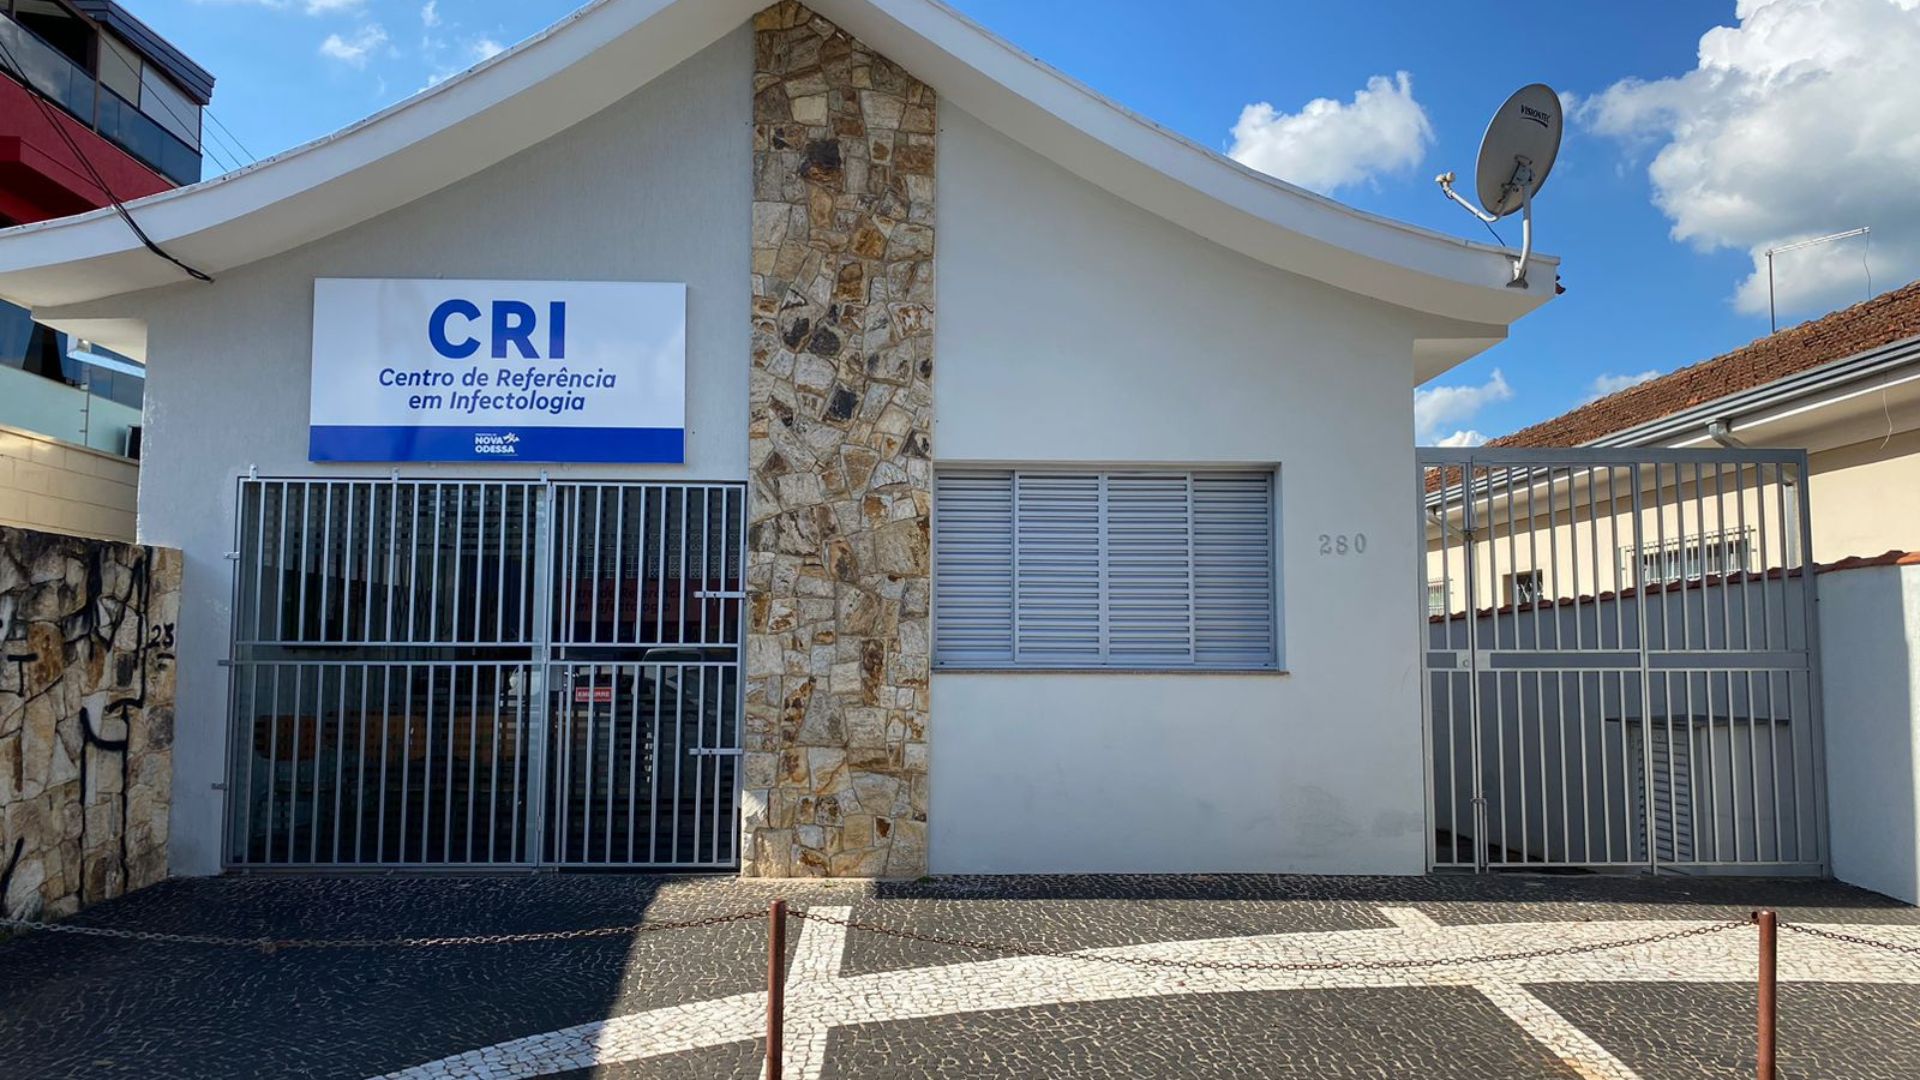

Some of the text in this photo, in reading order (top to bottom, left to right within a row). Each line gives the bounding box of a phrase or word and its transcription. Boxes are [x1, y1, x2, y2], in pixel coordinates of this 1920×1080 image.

[428, 298, 566, 359] CRI
[379, 366, 617, 391] Centro de Referência
[408, 389, 585, 414] em Infectologia
[475, 436, 503, 444] NOVA
[475, 445, 515, 453] ODESSA
[1318, 532, 1367, 556] 280
